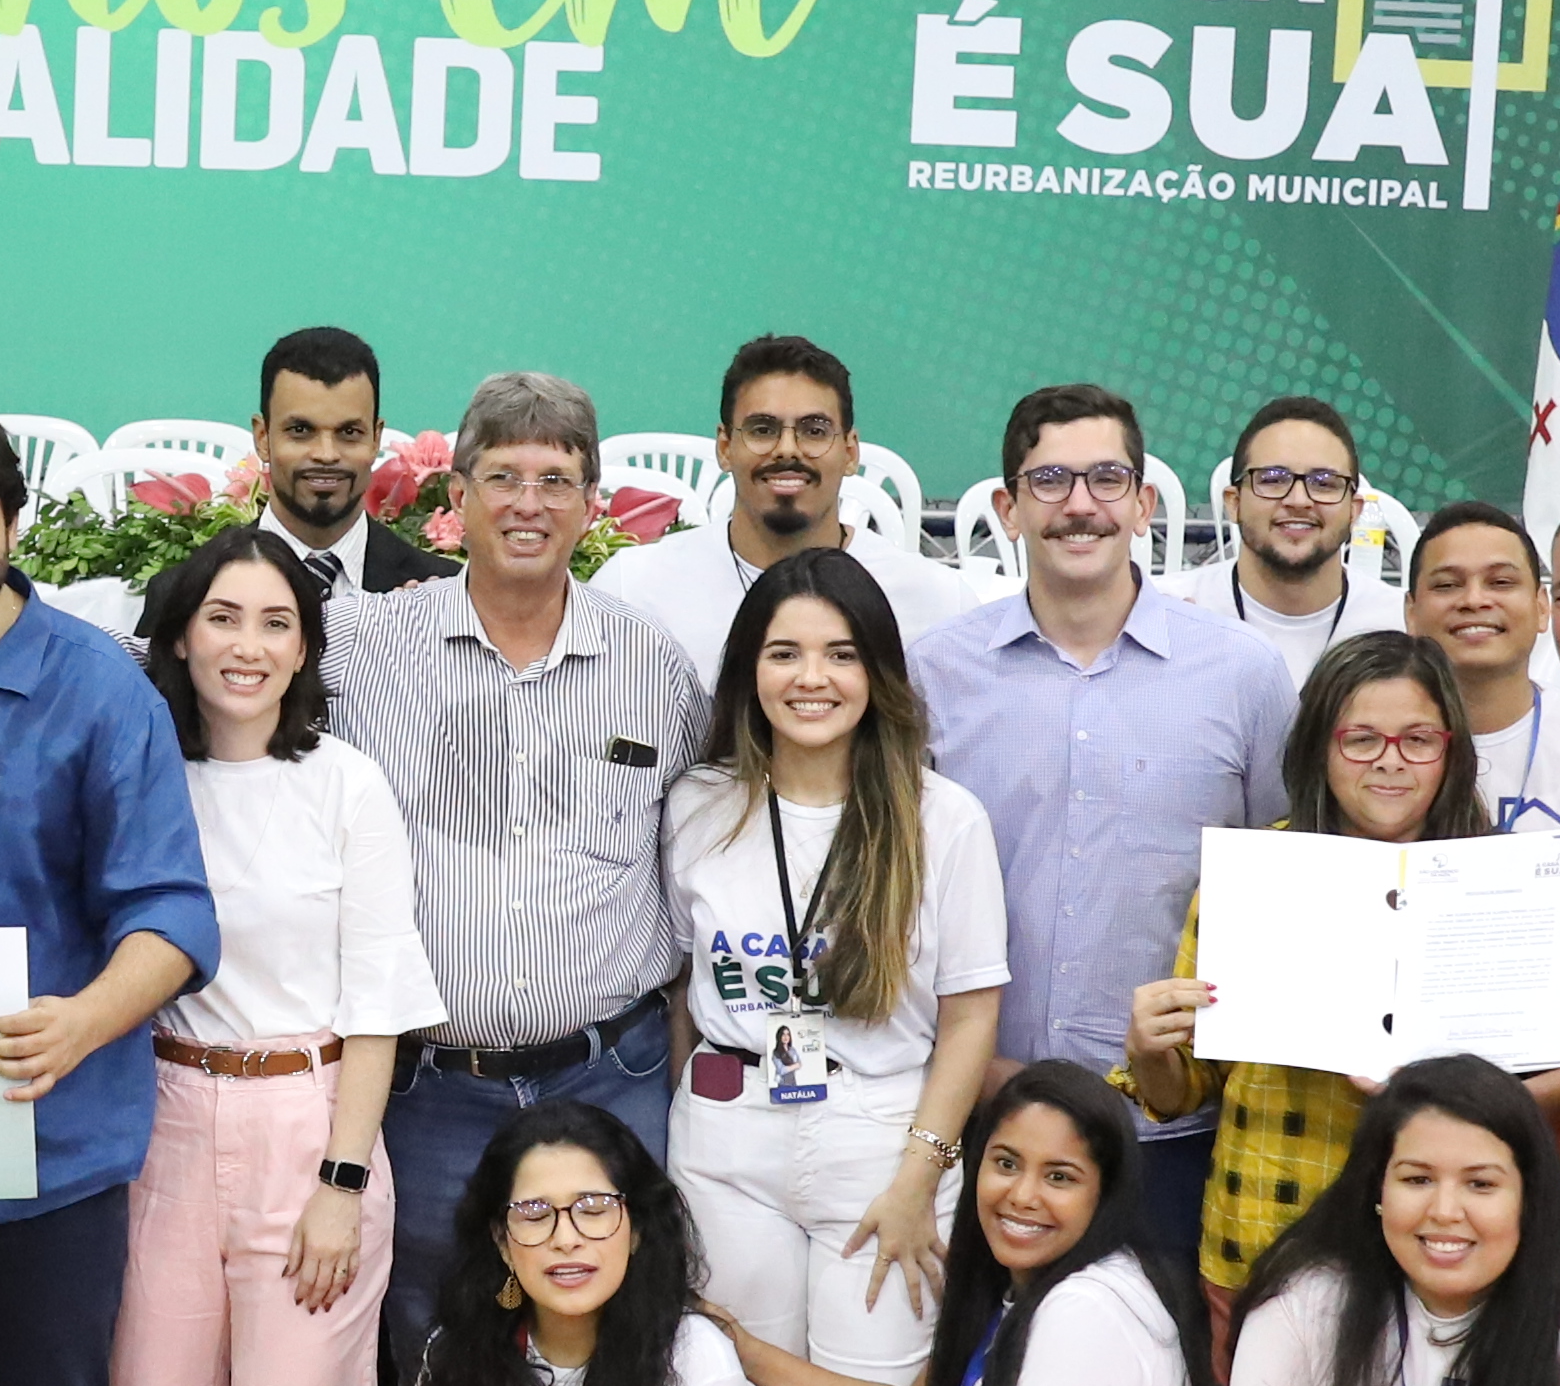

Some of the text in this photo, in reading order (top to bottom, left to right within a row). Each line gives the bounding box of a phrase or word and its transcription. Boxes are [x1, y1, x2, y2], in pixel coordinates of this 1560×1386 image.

[1055, 19, 1451, 167] SUA
[907, 160, 1450, 210] REURBANIZAÇÃO MUNICIPAL
[710, 930, 733, 955] A
[712, 955, 747, 1001] É
[780, 1089, 817, 1101] NATÁLIA
